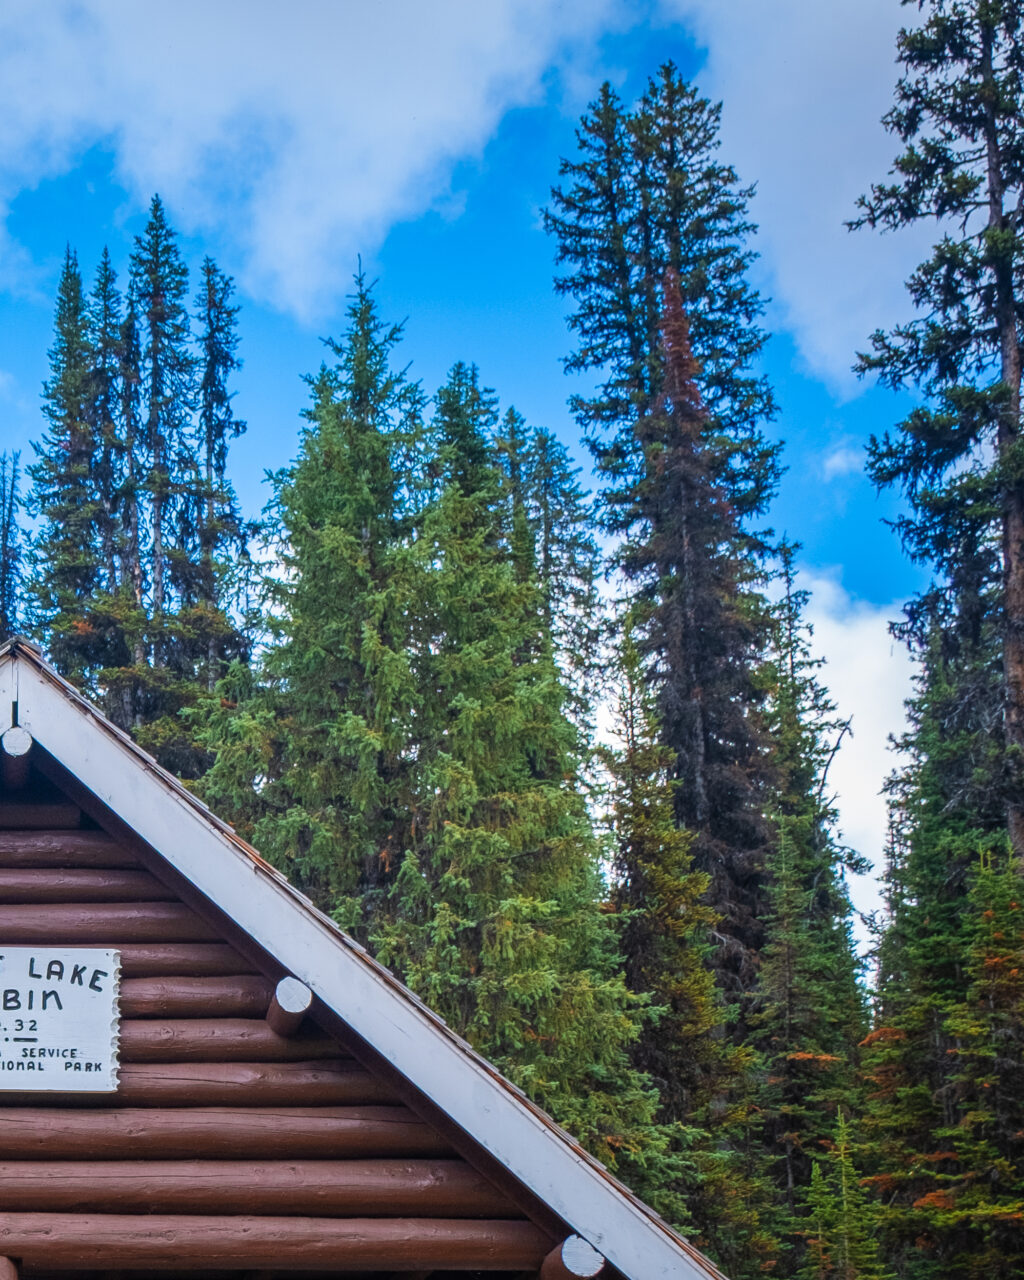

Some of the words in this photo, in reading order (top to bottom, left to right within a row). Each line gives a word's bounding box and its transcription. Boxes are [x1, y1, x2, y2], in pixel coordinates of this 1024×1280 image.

[28, 956, 110, 993] LAKE
[21, 1047, 78, 1059] SERVICE
[64, 1061, 102, 1073] PARK
